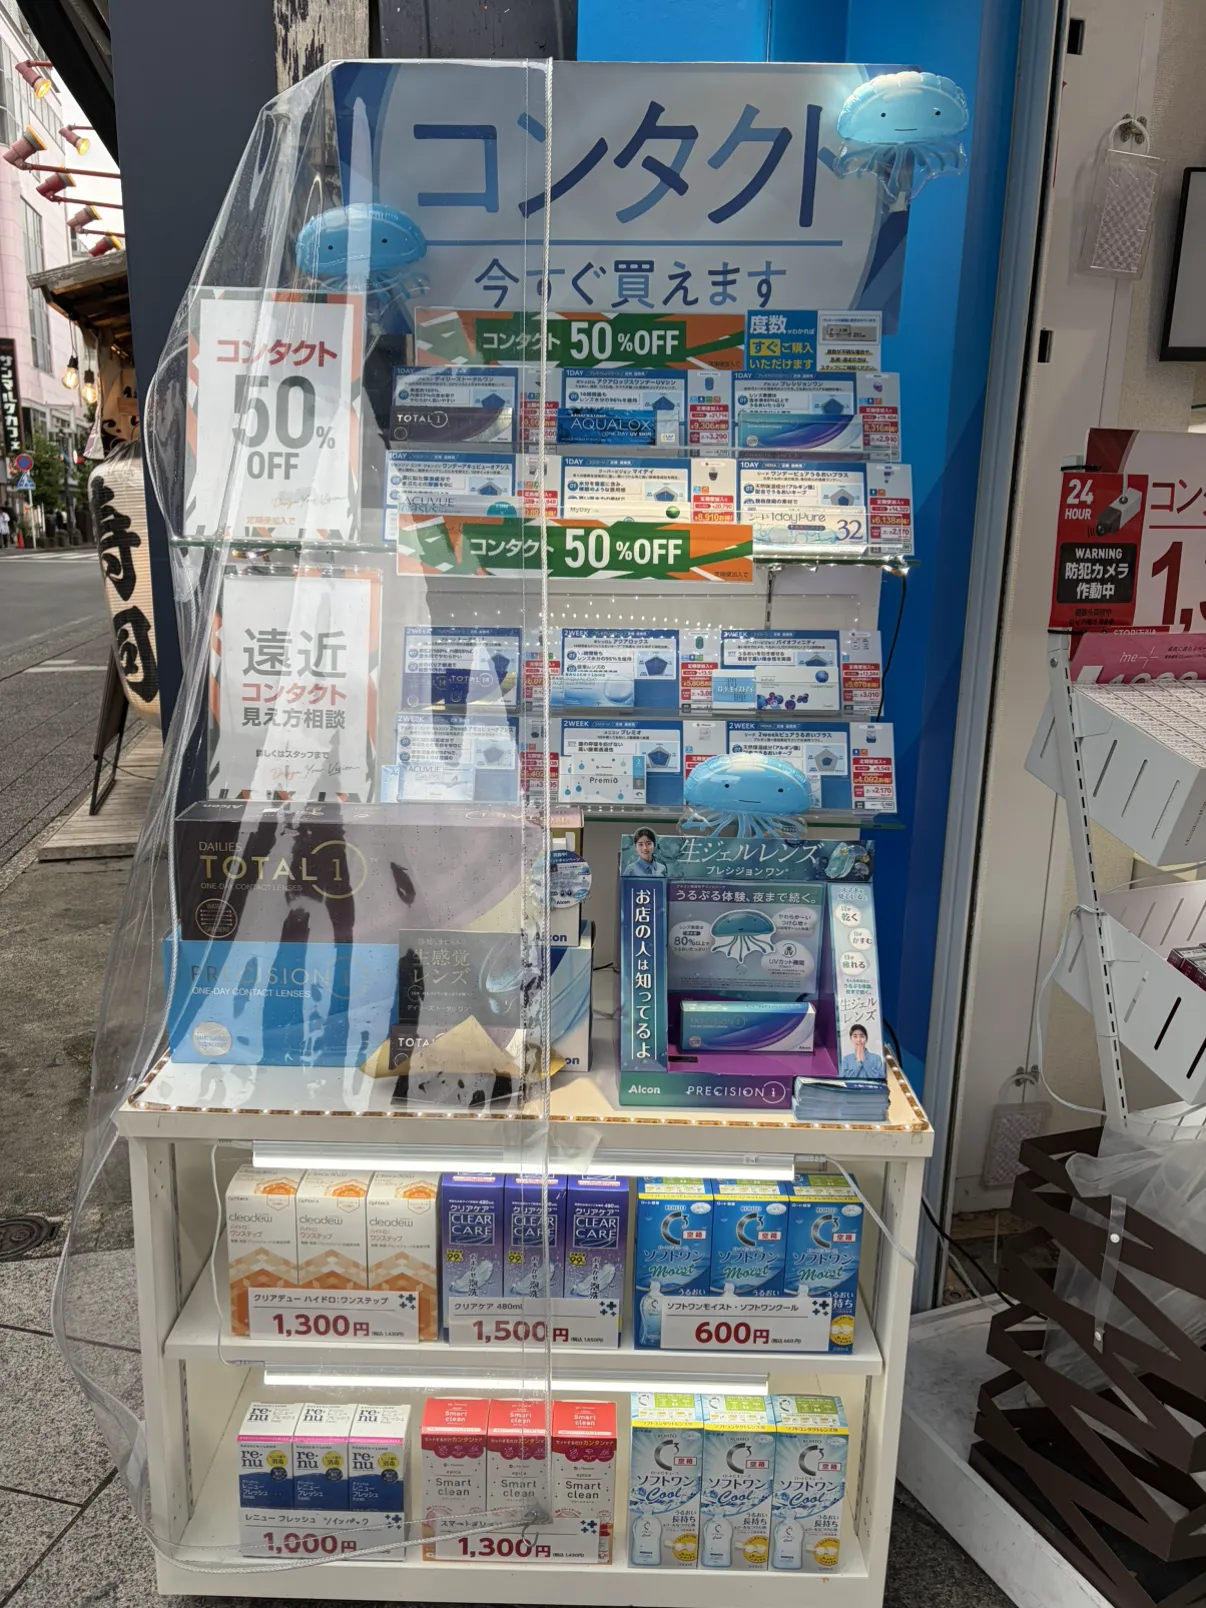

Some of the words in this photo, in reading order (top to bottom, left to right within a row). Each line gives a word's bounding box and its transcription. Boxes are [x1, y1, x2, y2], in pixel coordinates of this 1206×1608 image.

[412, 100, 846, 227] コンタクト
[475, 258, 786, 310] 今すぐ買えます
[216, 339, 338, 367] コンタクト
[751, 339, 814, 355] すぐご購入
[750, 359, 812, 370] いただけます
[0, 355, 20, 450] サンマルクカフェ
[232, 374, 335, 449] 50%
[397, 415, 432, 423] TOTAL
[570, 418, 652, 430] AQUALOX
[247, 451, 299, 480] OFF
[1066, 479, 1094, 504] 24
[1064, 508, 1092, 520] HOUR
[837, 520, 864, 541] 32
[1076, 548, 1122, 560] WARNING
[1065, 563, 1129, 579] 防犯カメラ
[91, 475, 160, 703] 寿司
[1076, 583, 1115, 599] 作動中
[242, 628, 347, 678] 遠近
[242, 682, 347, 706] コンタクト
[242, 707, 346, 729] 見え方相談
[256, 749, 329, 760] 詳しくはスタッフまで
[327, 762, 359, 777] Vision
[199, 842, 242, 851] DAILIES
[678, 839, 824, 864] 生ジェルレンズ
[201, 856, 318, 881] TOTAL
[332, 859, 342, 880] 1
[676, 890, 816, 904] うるぷる体験、夜まで続く。
[842, 913, 858, 922] 乾く
[413, 948, 470, 966] 生感覚
[190, 965, 329, 986] PRECISION
[413, 968, 470, 984] レンズ
[635, 890, 652, 1058] お店の人は知ってるよ
[191, 987, 230, 996] ONE-DAY
[232, 988, 273, 997] CONTACT
[276, 988, 311, 998] LENSES
[840, 997, 877, 1012] 生ジェル
[843, 1008, 877, 1023] レンズ
[398, 1038, 434, 1047] TOTA
[629, 1084, 660, 1094] Alcon
[688, 1085, 764, 1097] PRECISION
[229, 1213, 272, 1223] cleadew
[300, 1215, 343, 1225] cleadew
[369, 1217, 413, 1228] cleadew
[451, 1214, 492, 1224] CLEAR
[514, 1217, 555, 1226] CLEAR
[576, 1218, 617, 1227] CLEAR
[300, 1232, 332, 1240] ワンステップ
[451, 1226, 492, 1235] CARE
[576, 1229, 616, 1239] CARE
[644, 1250, 704, 1263] ソフトワン
[719, 1252, 779, 1264] ソフトワン
[793, 1253, 853, 1266] ソフトワン
[649, 1264, 695, 1278] Moist
[724, 1266, 769, 1280] Moist
[304, 1295, 388, 1305] ハイドロ:ワンステップ
[834, 1300, 853, 1308] 持ち
[667, 1303, 799, 1312] ソフトワンモイスト・ソフトワンクール
[273, 1314, 370, 1338] 1,300円
[473, 1320, 569, 1342] 1,500円
[695, 1322, 769, 1344] 600円
[241, 1459, 263, 1467] nu
[297, 1460, 319, 1468] nu
[436, 1478, 472, 1487] Smart
[501, 1479, 536, 1488] Smart
[565, 1480, 601, 1490] Smart
[637, 1475, 695, 1487] ソフトワン
[709, 1478, 766, 1489] ソフトワン
[781, 1480, 838, 1491] ソフトワン
[438, 1487, 470, 1496] clean
[503, 1489, 535, 1498] clean
[567, 1490, 599, 1500] clean
[646, 1487, 682, 1501] Cool
[718, 1490, 753, 1504] Cool
[789, 1493, 824, 1507] Cool
[279, 1515, 316, 1523] フレッシュ
[743, 1518, 767, 1526] 長持ち
[814, 1520, 838, 1528] 長持ち
[264, 1532, 357, 1554] 1,000円
[458, 1537, 550, 1558] 1,300円
